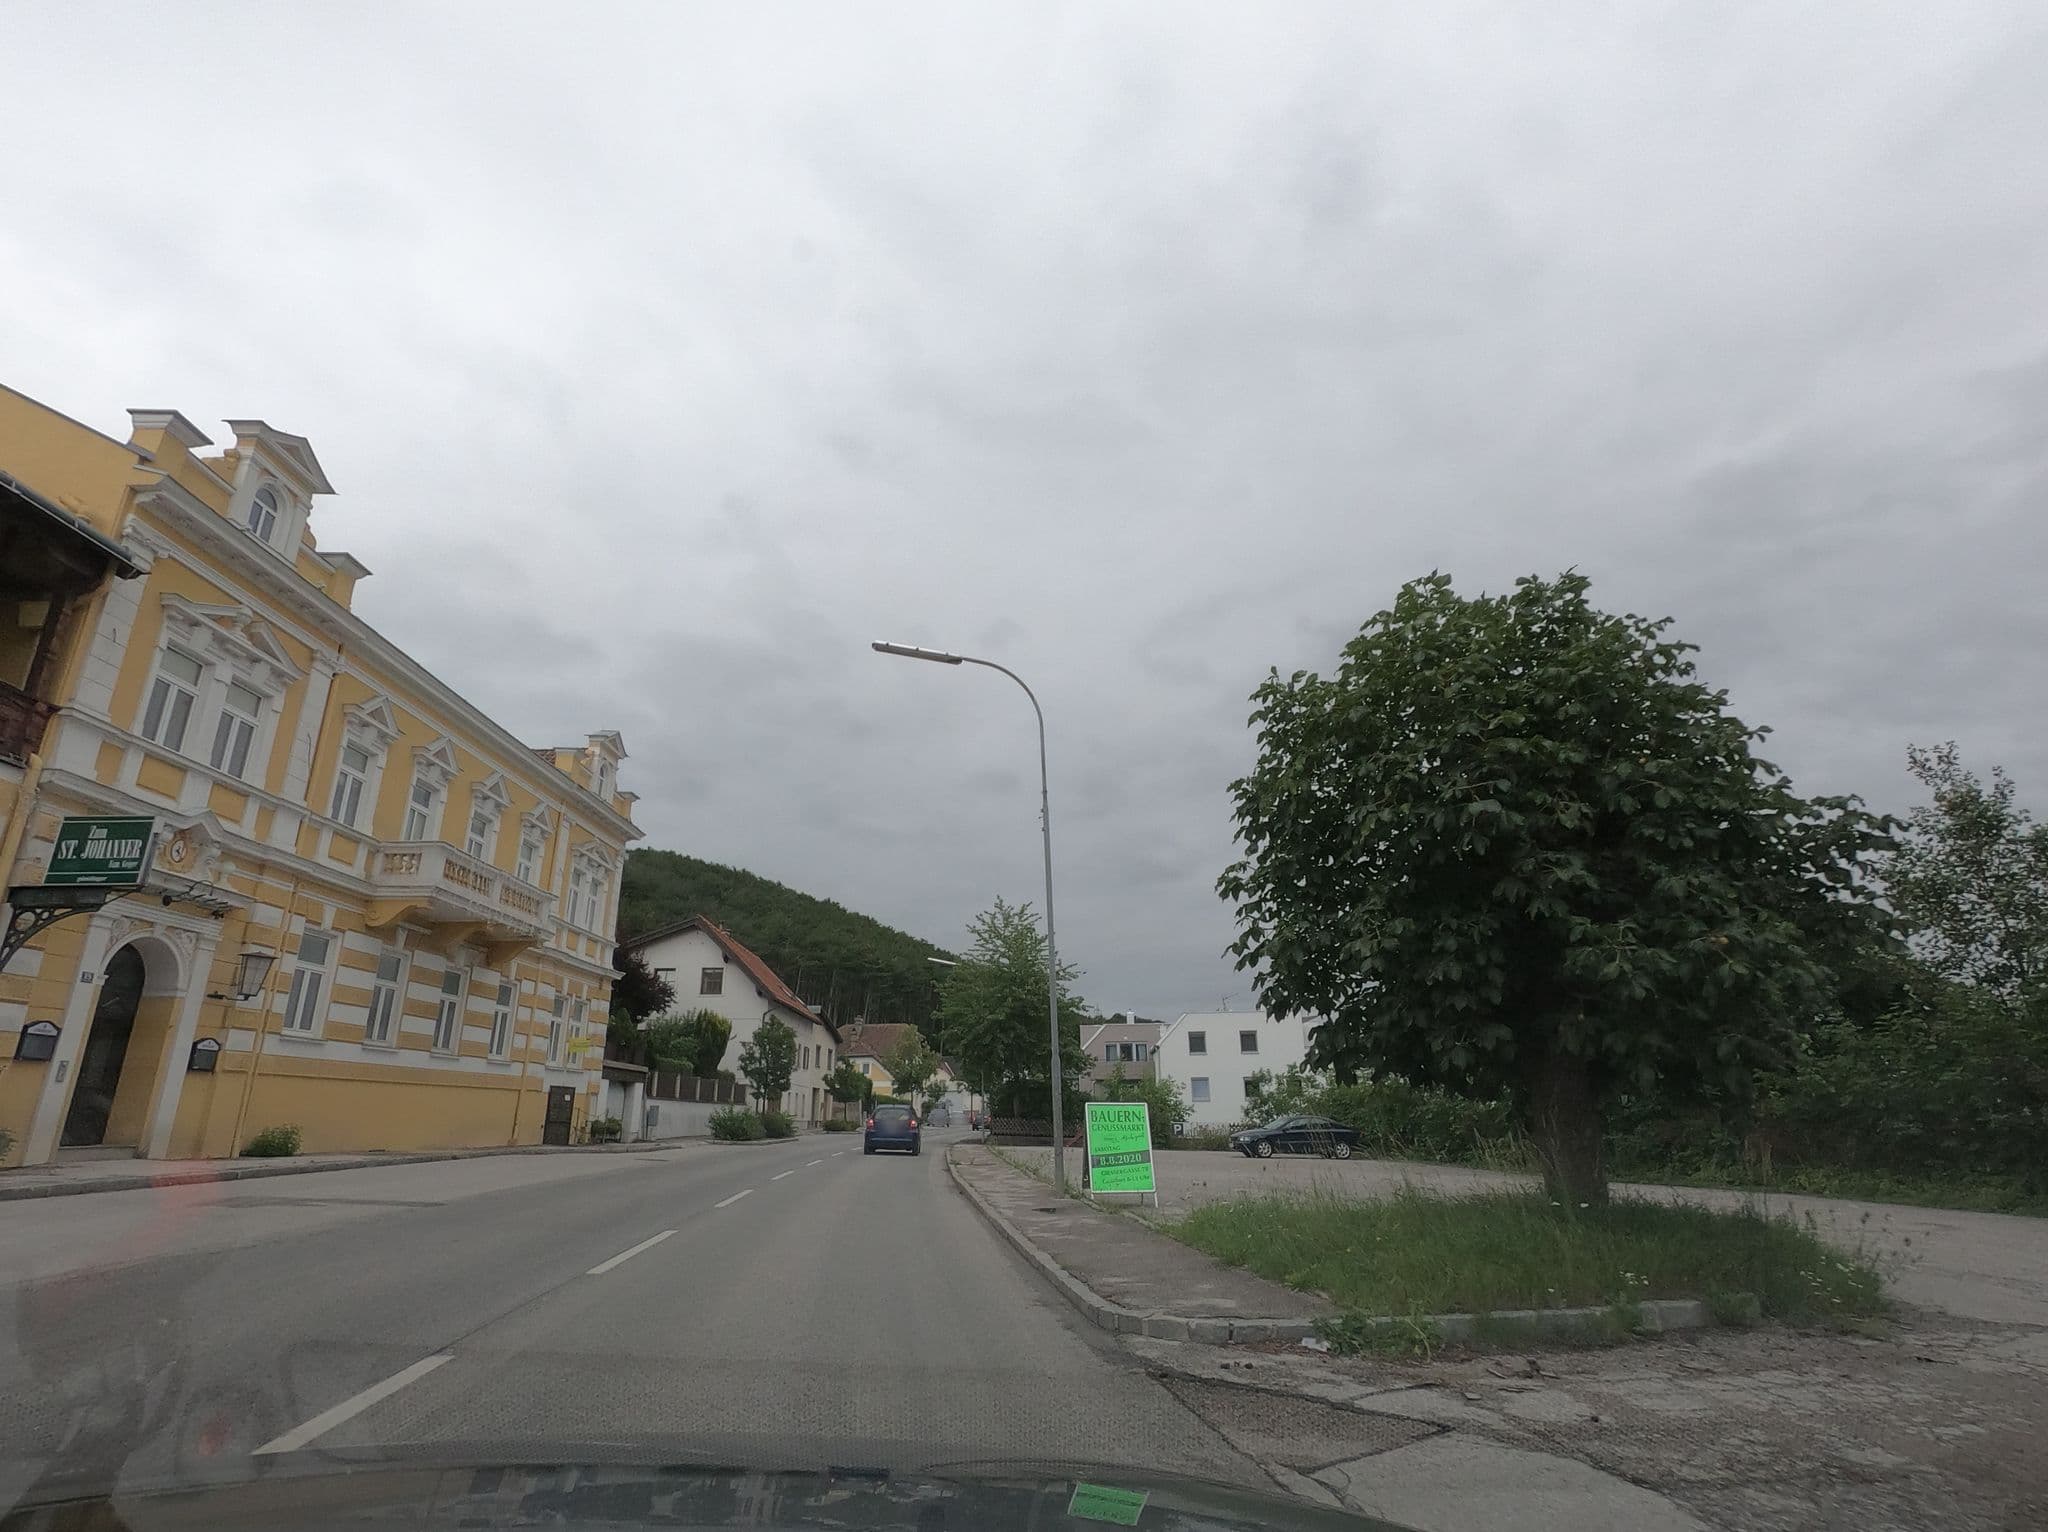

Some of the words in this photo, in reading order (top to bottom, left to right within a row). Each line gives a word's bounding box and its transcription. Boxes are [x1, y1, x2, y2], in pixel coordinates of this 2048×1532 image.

[88, 825, 108, 839] Zum
[58, 839, 79, 859] ST.
[1091, 1110, 1145, 1123] BAUERN-
[1092, 1123, 1145, 1132] GENUSSMARKT
[1173, 1124, 1182, 1135] P
[1095, 1145, 1121, 1153] SAMSTAG
[1100, 1154, 1142, 1166] 8.8.2020
